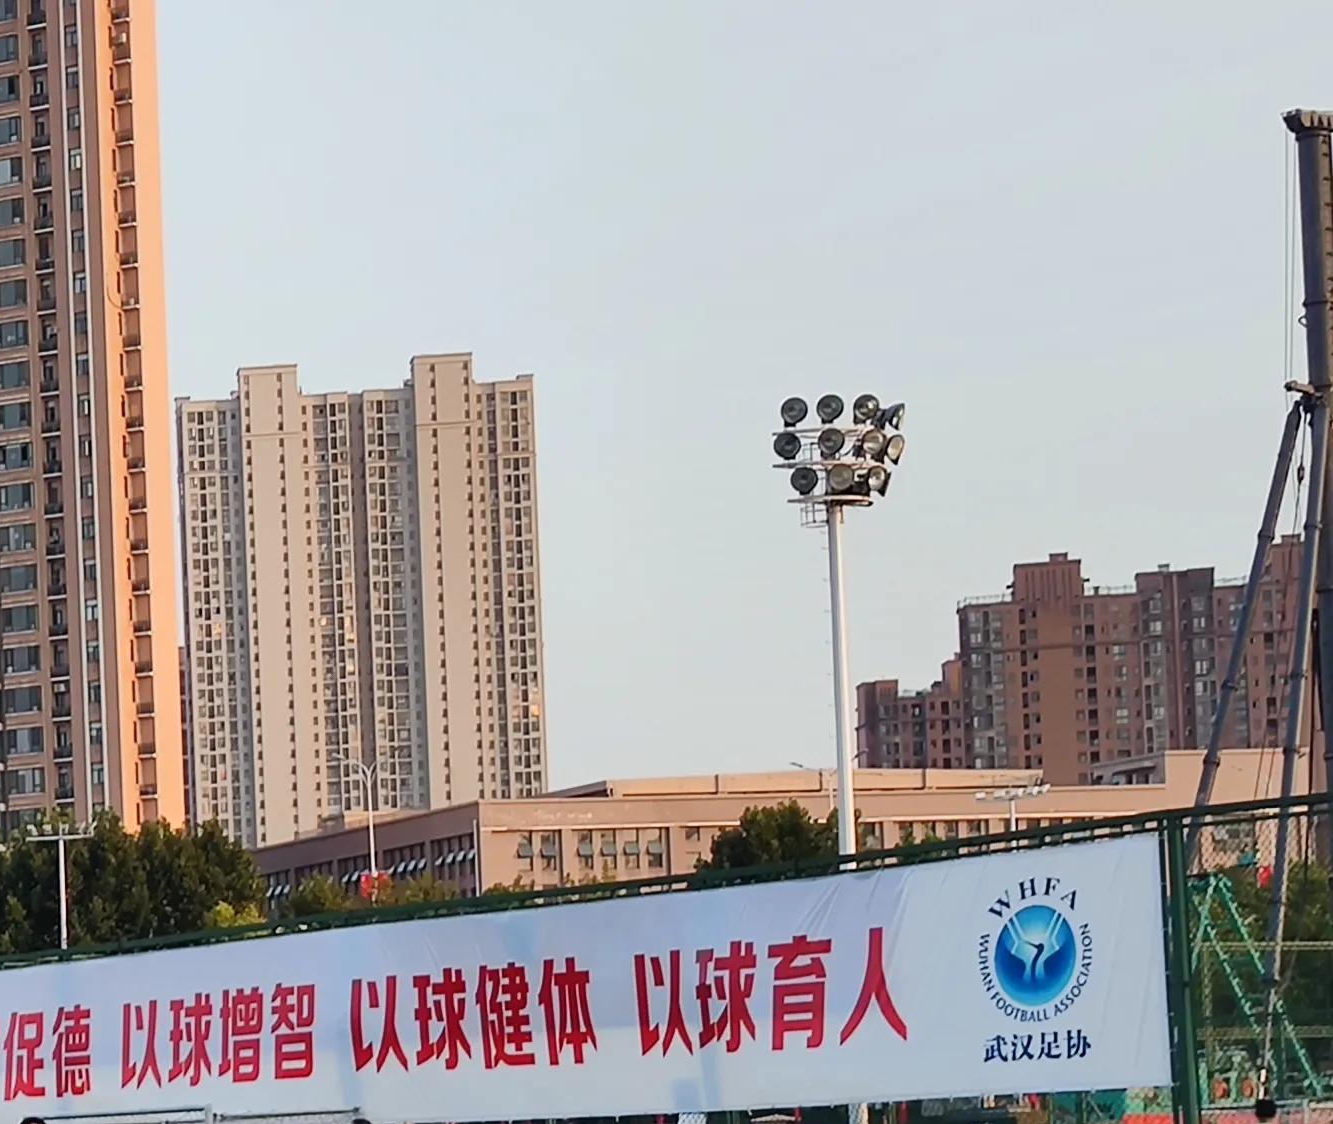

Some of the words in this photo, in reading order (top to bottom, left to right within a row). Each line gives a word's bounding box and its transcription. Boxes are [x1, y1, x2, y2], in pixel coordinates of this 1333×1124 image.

[988, 877, 1078, 919] WHFA
[978, 933, 995, 993] WUHAN
[990, 991, 1050, 1022] FOOTBALL
[1053, 922, 1093, 1017] ASSOCIATION
[120, 983, 316, 1089] 以球增智
[349, 957, 598, 1073] 以球健体
[633, 927, 907, 1057] 以球育人
[983, 1029, 1092, 1063] 武汉足协
